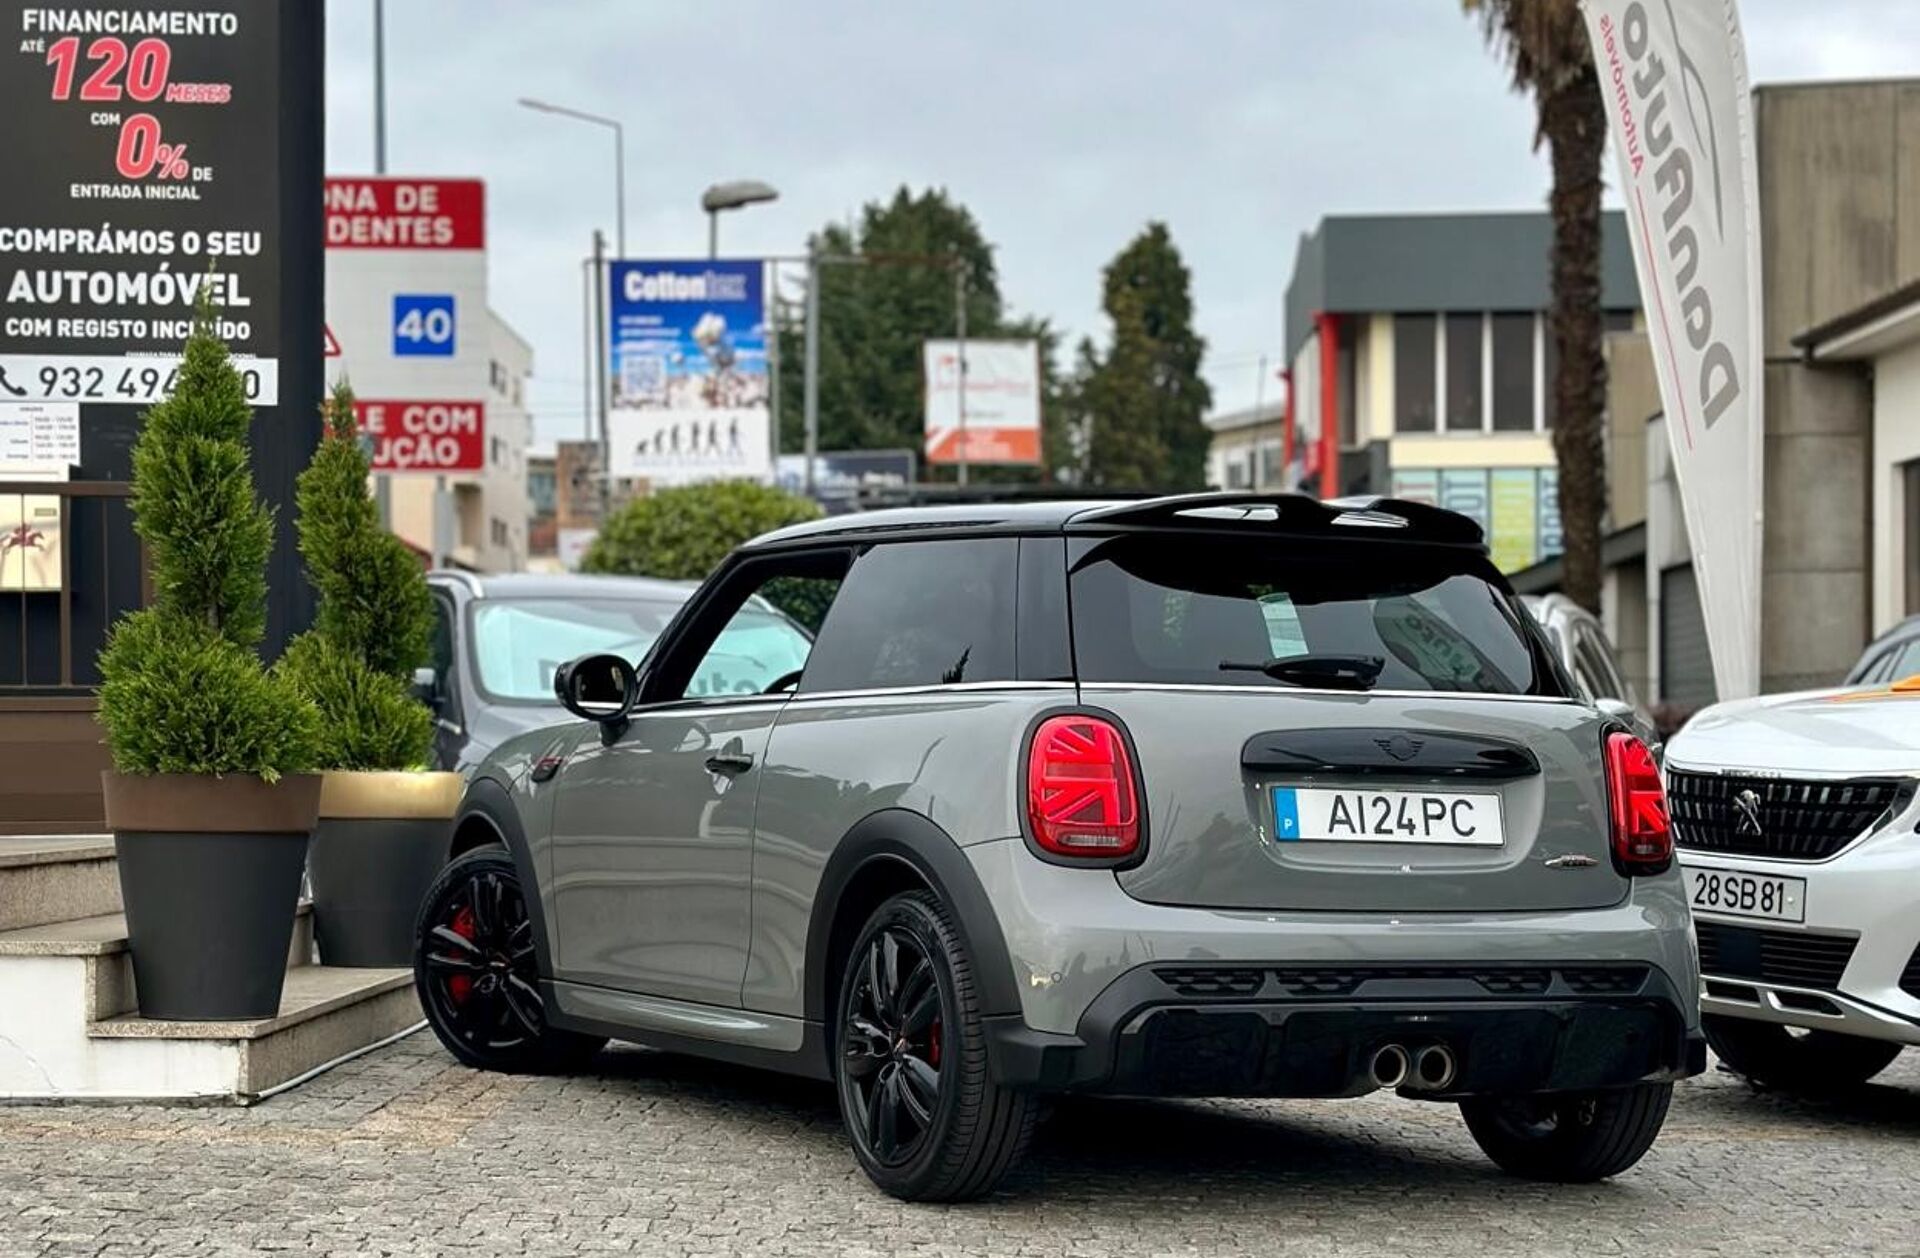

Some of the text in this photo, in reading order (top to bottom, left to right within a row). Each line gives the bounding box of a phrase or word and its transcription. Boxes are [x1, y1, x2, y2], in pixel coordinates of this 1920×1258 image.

[22, 9, 238, 35] FINANCIAMENTO
[20, 37, 232, 103] ATÉ 120 MESES
[90, 112, 213, 181] COM 0% DE
[70, 184, 200, 200] ENTRADA INICIAL
[325, 185, 439, 212] NA DE
[0, 222, 261, 256] COMPRÁMOS O SEU
[327, 216, 454, 245] DENTES
[6, 262, 251, 307] AUTOMÓVEL
[5, 316, 251, 340] COM REGISTO INCÍDO
[397, 308, 452, 344] 40
[39, 366, 104, 397] 932
[402, 405, 478, 434] COM
[1284, 817, 1293, 829] P
